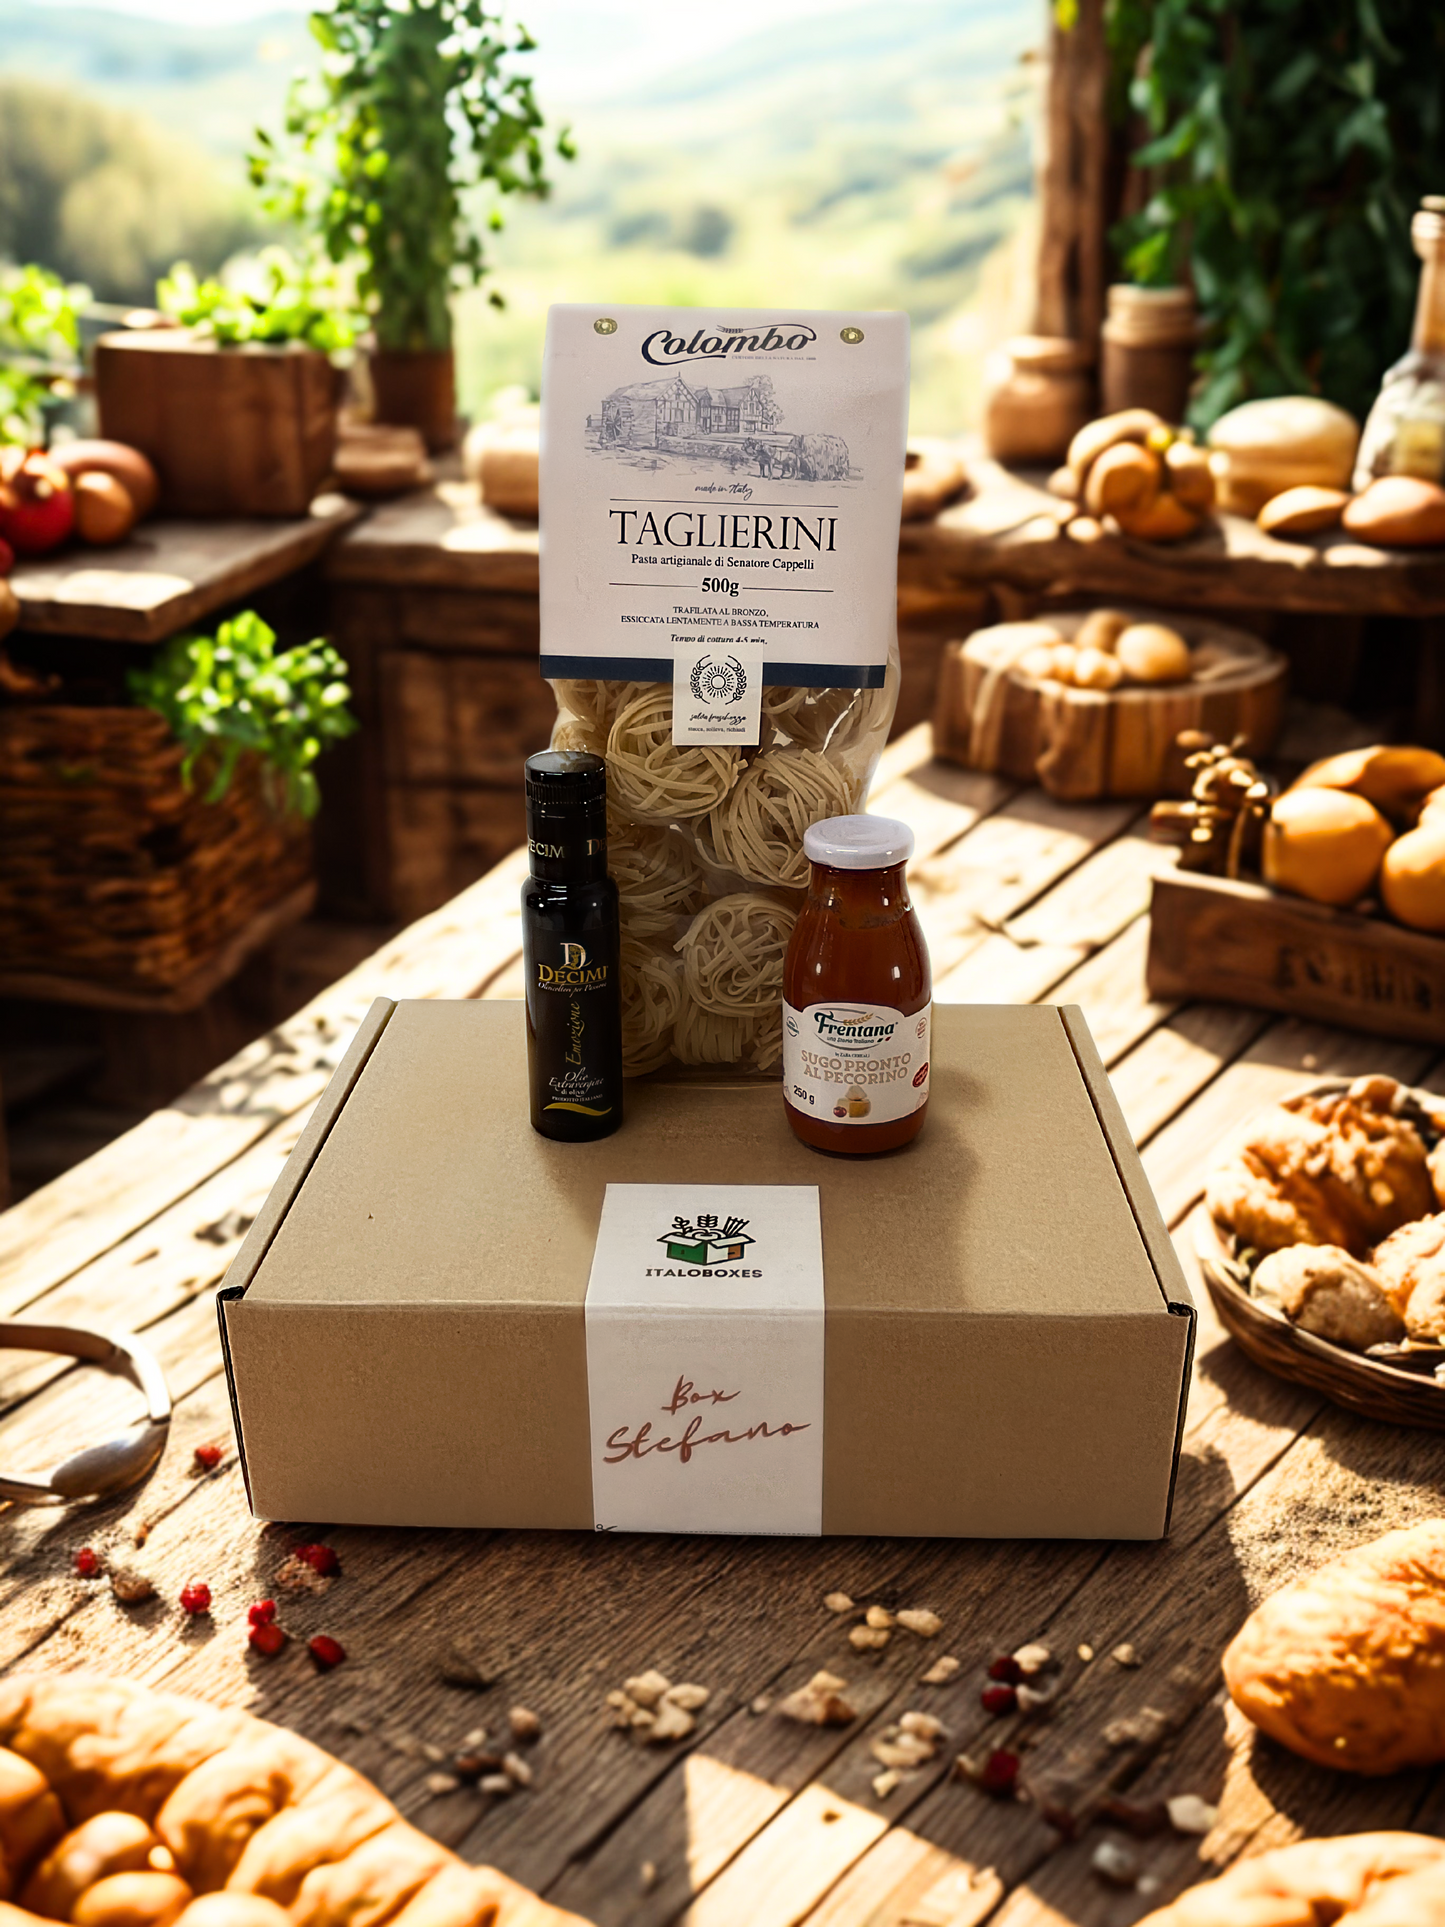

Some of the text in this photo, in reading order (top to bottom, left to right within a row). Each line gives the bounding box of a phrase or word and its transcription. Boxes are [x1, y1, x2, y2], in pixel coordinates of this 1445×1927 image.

[641, 324, 817, 366] Colombo
[695, 482, 717, 493] made
[728, 482, 753, 501] Italy
[609, 509, 839, 552] TAGLIERINI
[631, 554, 815, 571] Pasta artigianale di Senatore Cappelli
[701, 577, 740, 598] 500g
[620, 615, 820, 629] ESSICCATA LENTAMENTE A BASSA TEMPERATURA
[672, 606, 769, 617] TRAFILATA AL BRONZO,
[697, 635, 706, 643] di
[537, 963, 608, 984] DECIMI
[814, 1010, 896, 1038] Frentana
[801, 1050, 911, 1072] SUGO PRONTO
[803, 1064, 822, 1080] AL
[823, 1066, 908, 1085] PECORINO
[793, 1084, 815, 1105] 250 g
[645, 1267, 763, 1279] ITALOBOXES
[661, 1374, 742, 1416] Box
[602, 1415, 812, 1464] Stefano
